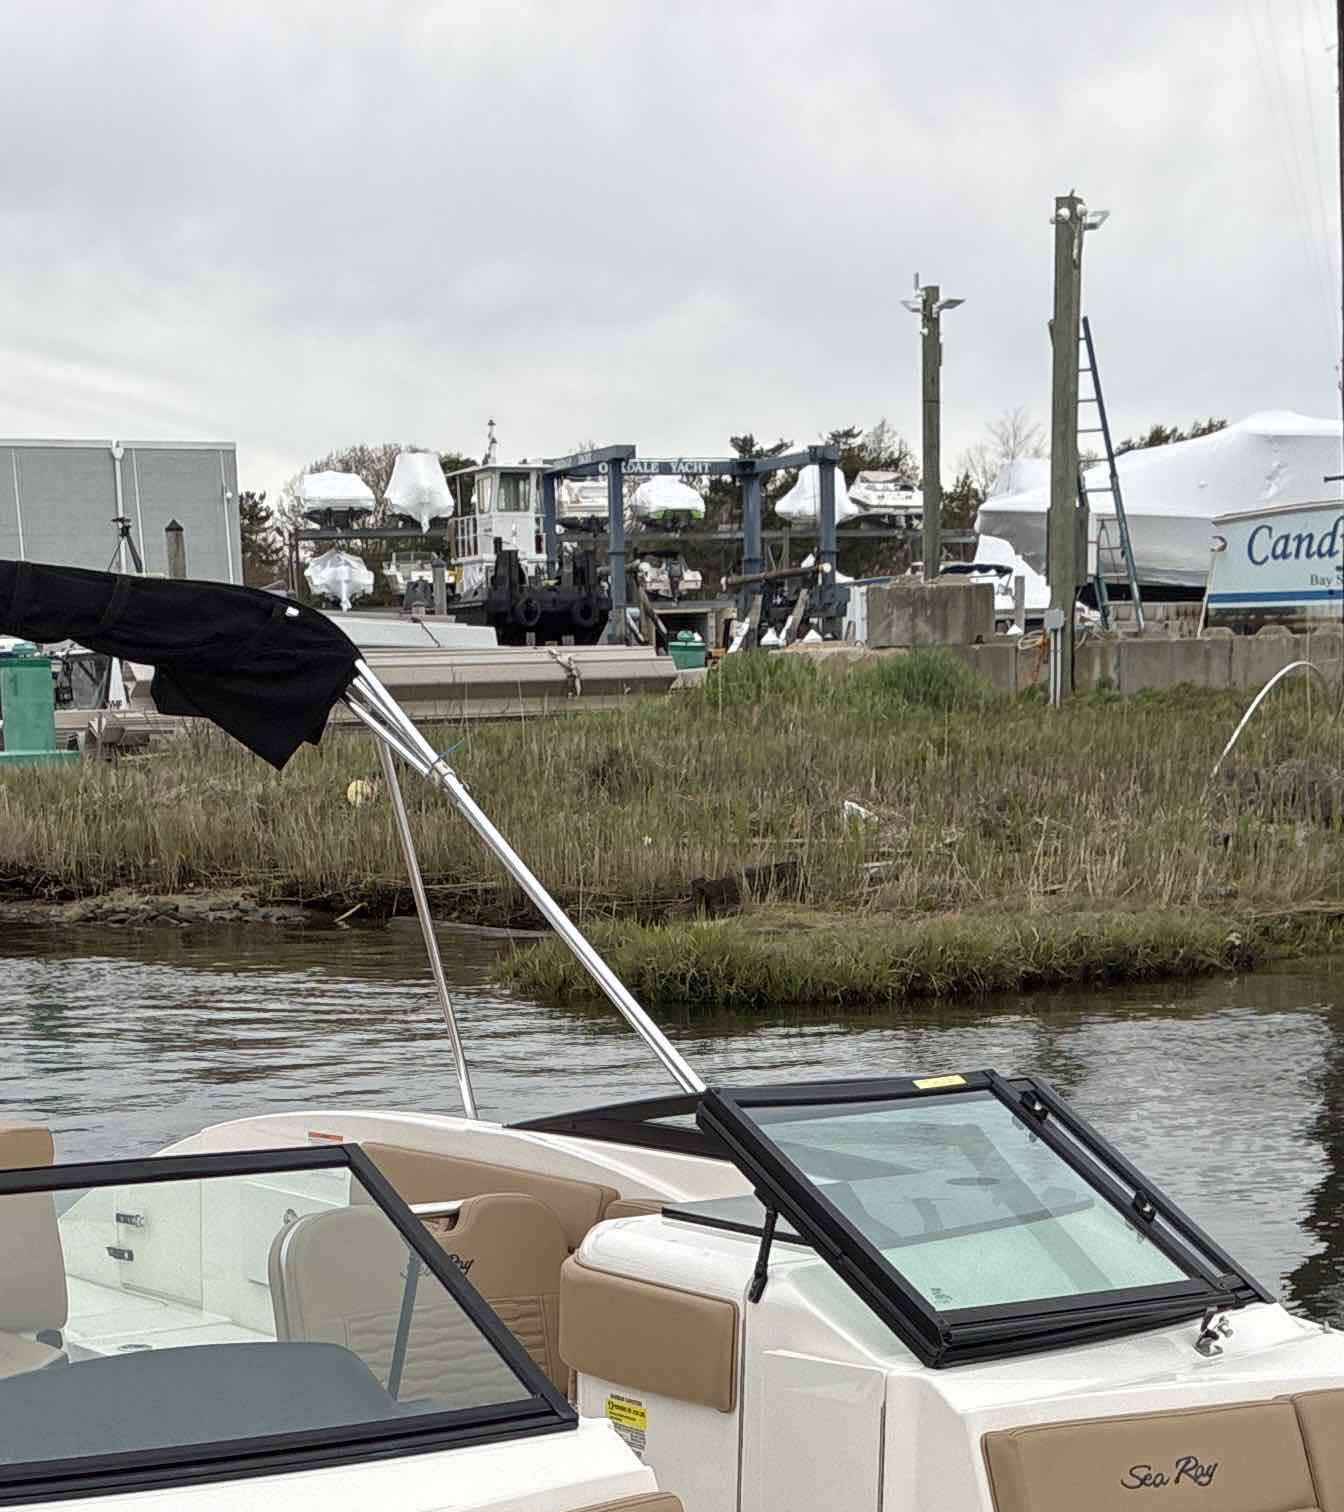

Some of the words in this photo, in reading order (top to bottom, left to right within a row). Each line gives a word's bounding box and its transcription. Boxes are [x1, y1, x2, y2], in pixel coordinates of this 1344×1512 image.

[670, 462, 712, 474] YACHT
[1247, 515, 1344, 566] Cand
[1119, 1464, 1170, 1490] Sea
[1175, 1455, 1218, 1487] Ray
